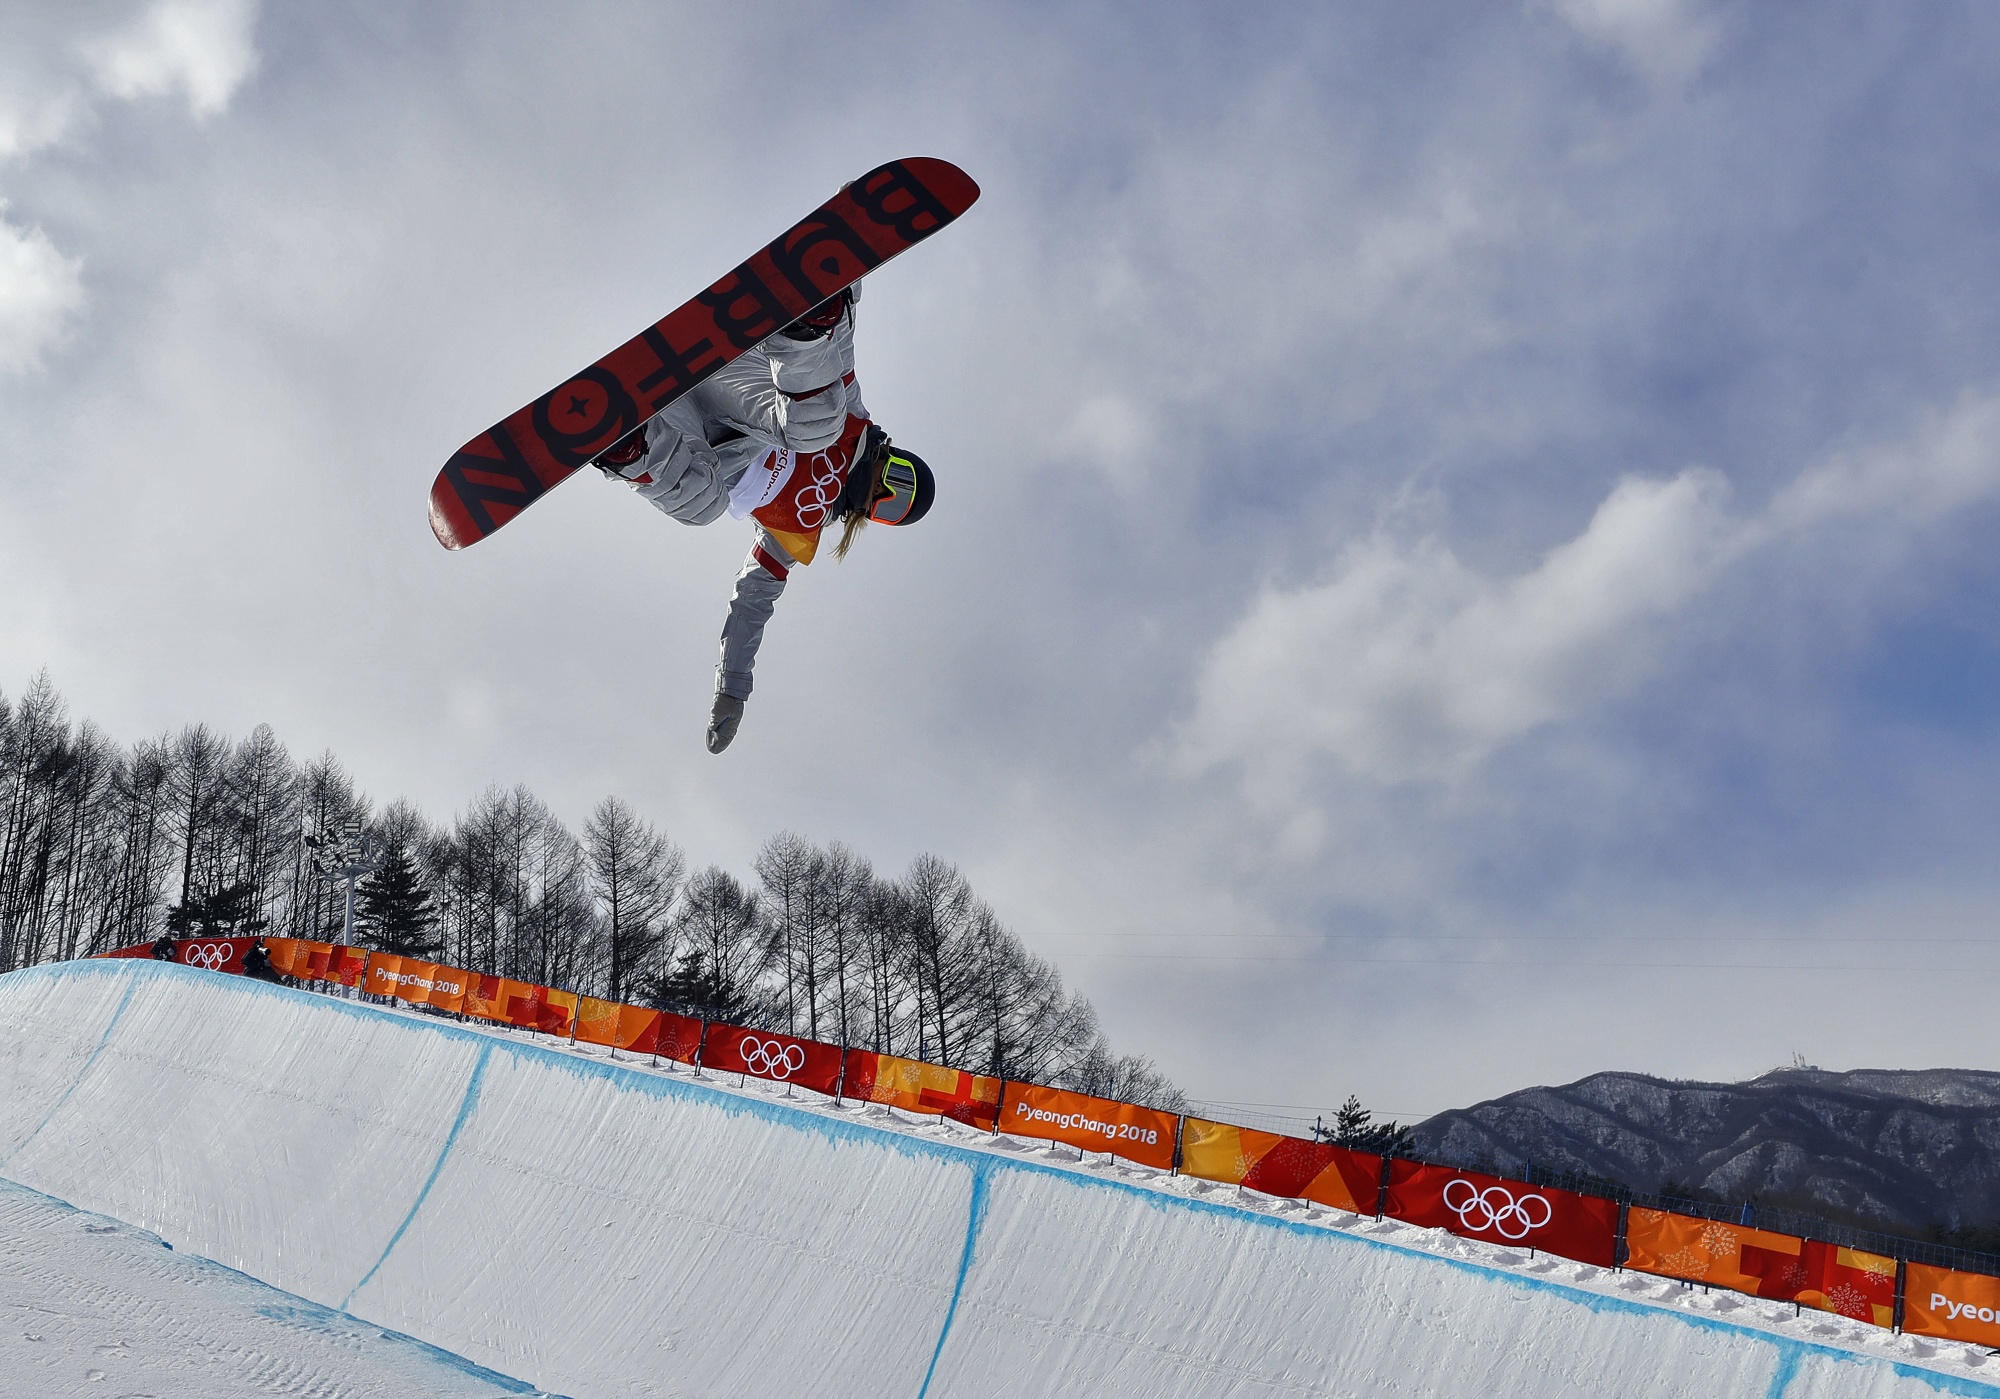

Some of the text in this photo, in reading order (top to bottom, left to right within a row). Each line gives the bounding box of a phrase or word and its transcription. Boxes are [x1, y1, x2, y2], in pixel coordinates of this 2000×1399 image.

[454, 160, 956, 536] BURTON
[376, 967, 459, 994] PyeongChang 2018
[1016, 1101, 1158, 1145] PyeongChang 2018
